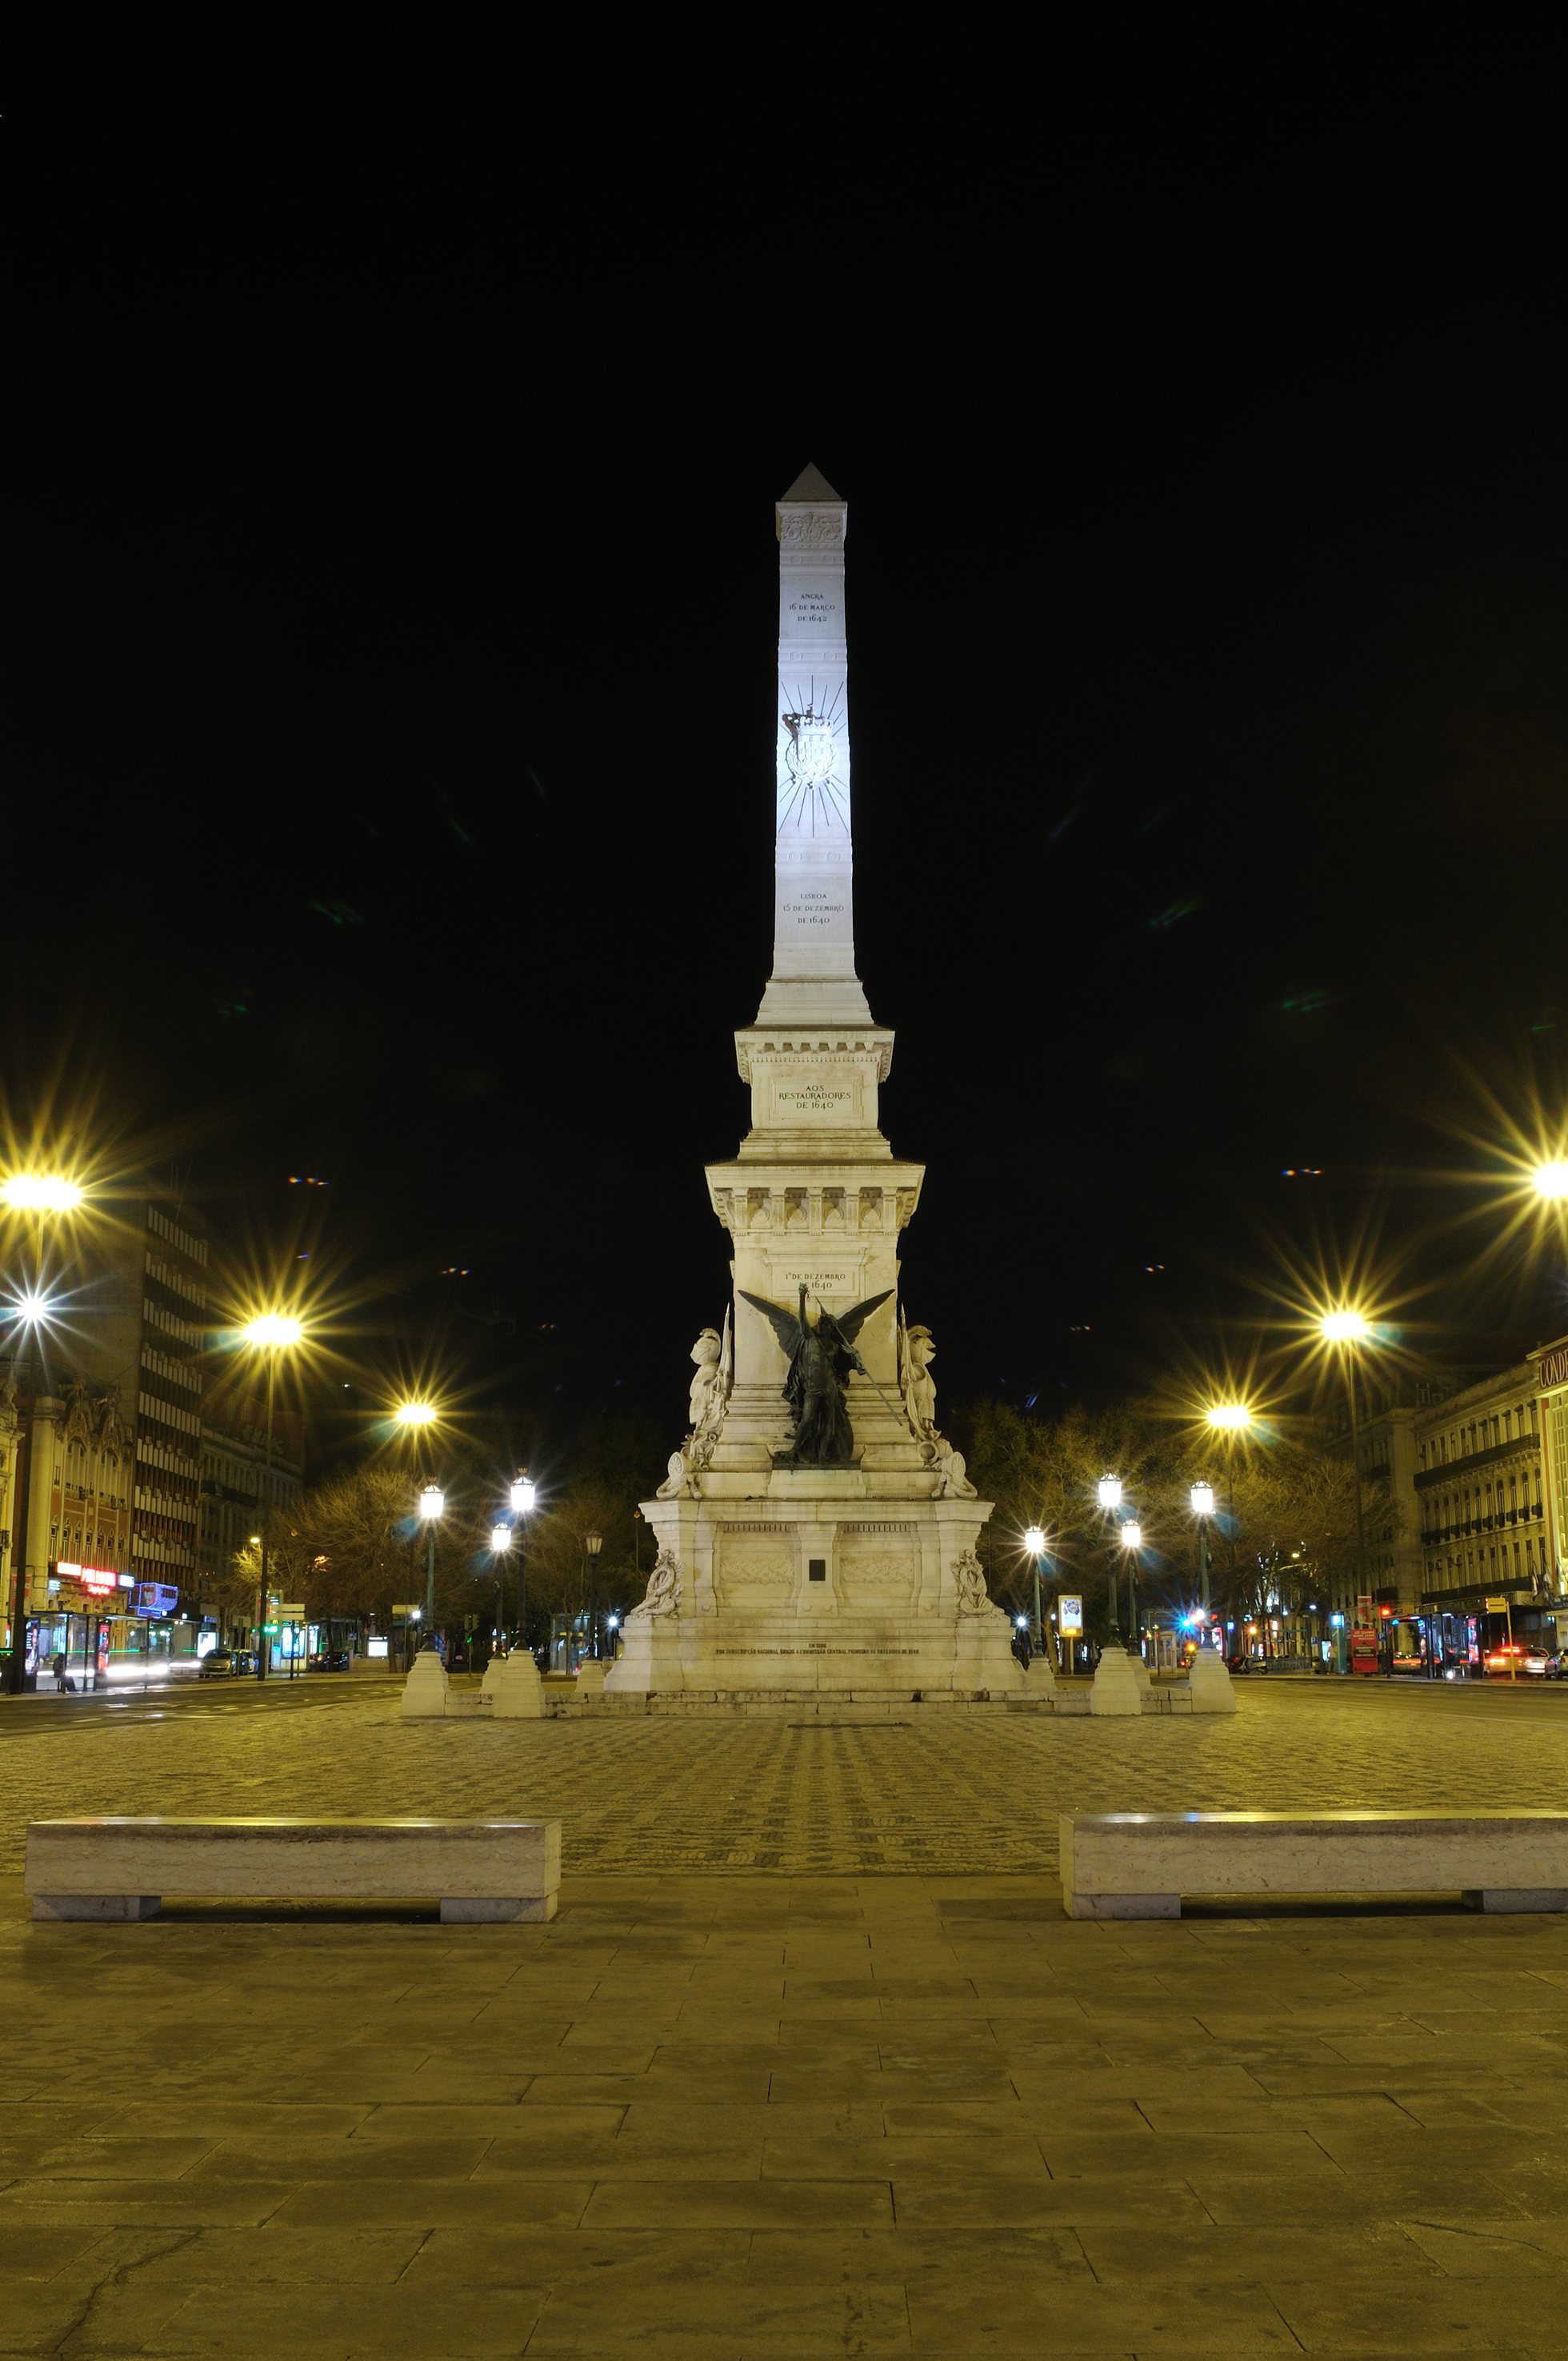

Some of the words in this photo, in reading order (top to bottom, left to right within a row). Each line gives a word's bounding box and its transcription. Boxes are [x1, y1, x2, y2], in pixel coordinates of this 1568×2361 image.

[789, 602, 797, 610] 16
[809, 614, 827, 623] 1642
[783, 903, 791, 911] 15
[805, 905, 845, 913] DEZEMBRO
[810, 915, 830, 925] 1640
[778, 1092, 851, 1100] RESTAURADORES
[811, 1100, 834, 1110] 1640
[804, 1273, 846, 1281] DEZEMBRO
[811, 1280, 833, 1290] 1640
